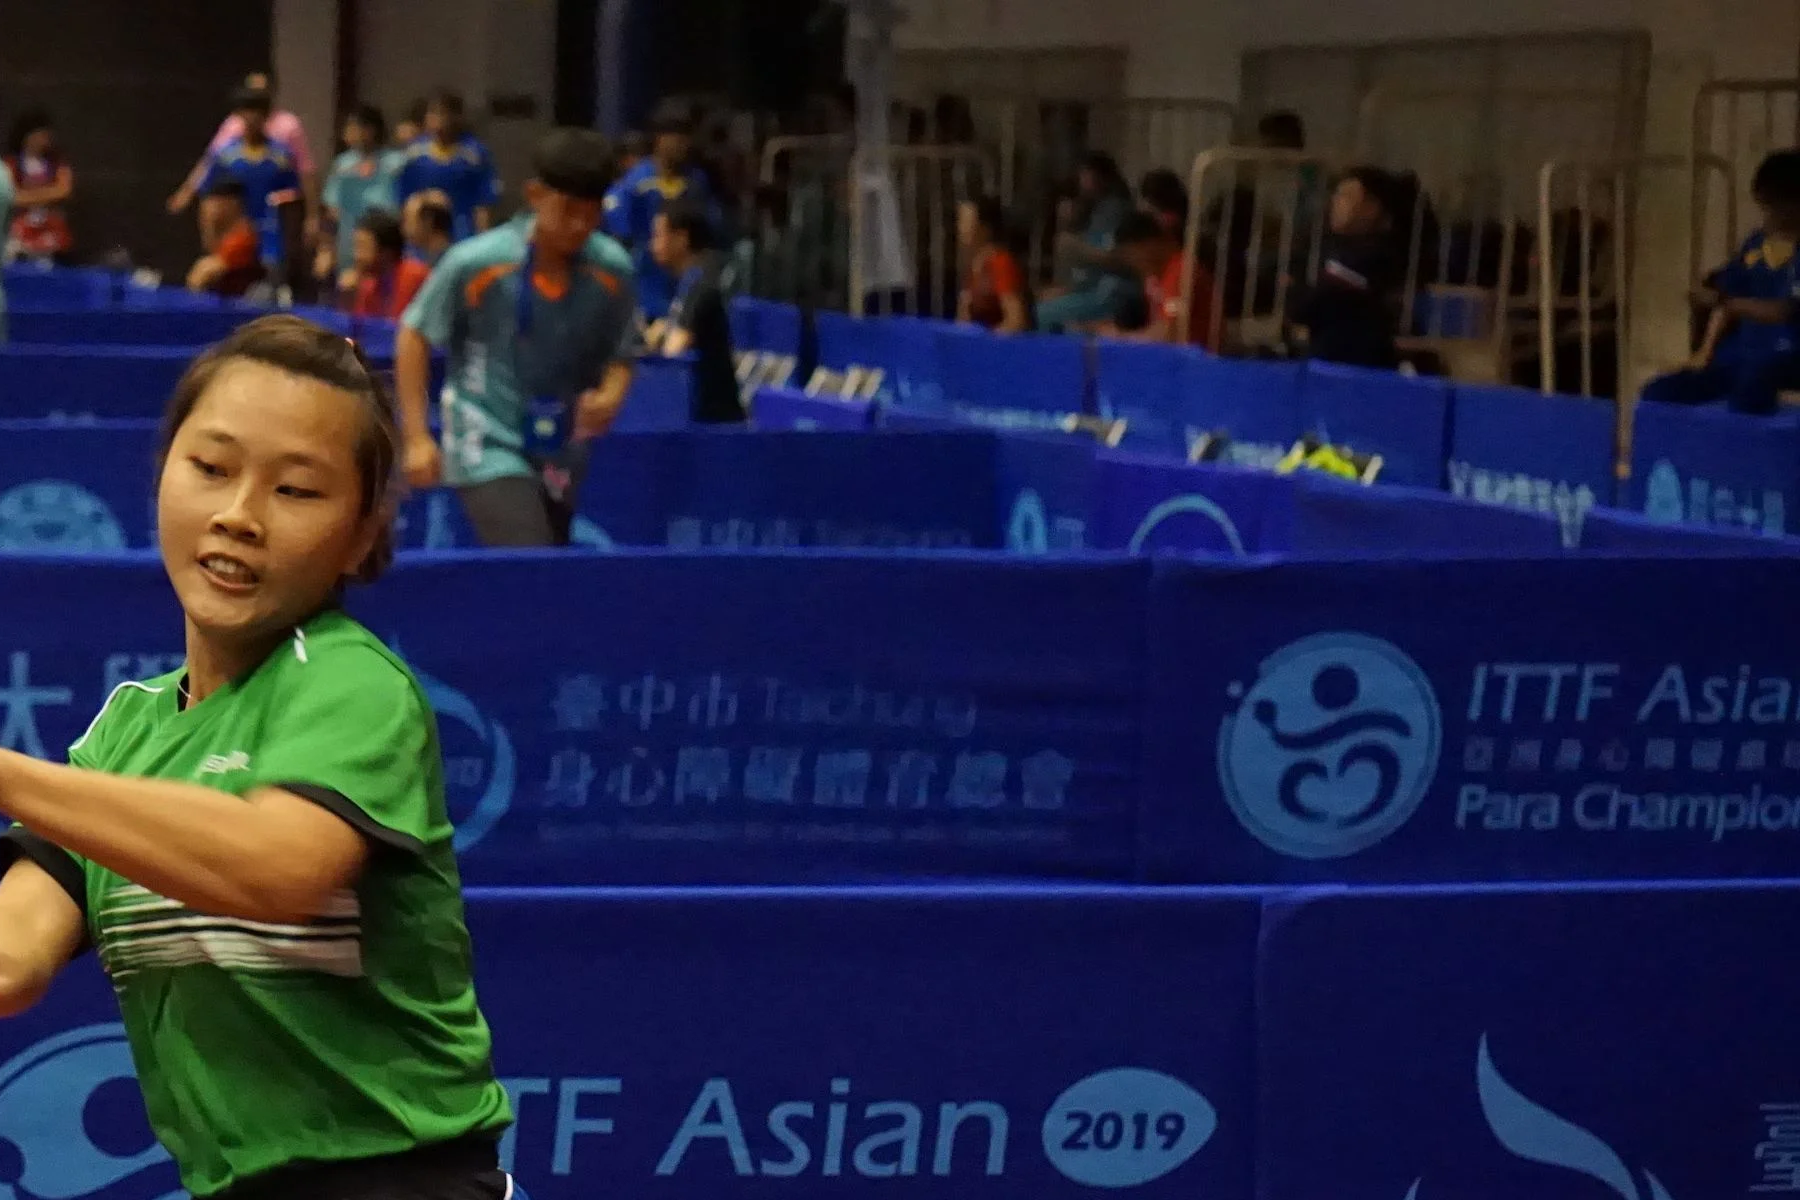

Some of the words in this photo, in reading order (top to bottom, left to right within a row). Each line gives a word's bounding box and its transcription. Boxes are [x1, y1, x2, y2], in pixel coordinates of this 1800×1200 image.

[1467, 663, 1620, 723] ITTF
[1637, 663, 1800, 724] Asia
[1455, 783, 1561, 830] Para
[1573, 781, 1800, 843] Champio
[502, 1078, 622, 1176] TF
[656, 1078, 1009, 1177] Asian
[1061, 1110, 1187, 1152] 2019
